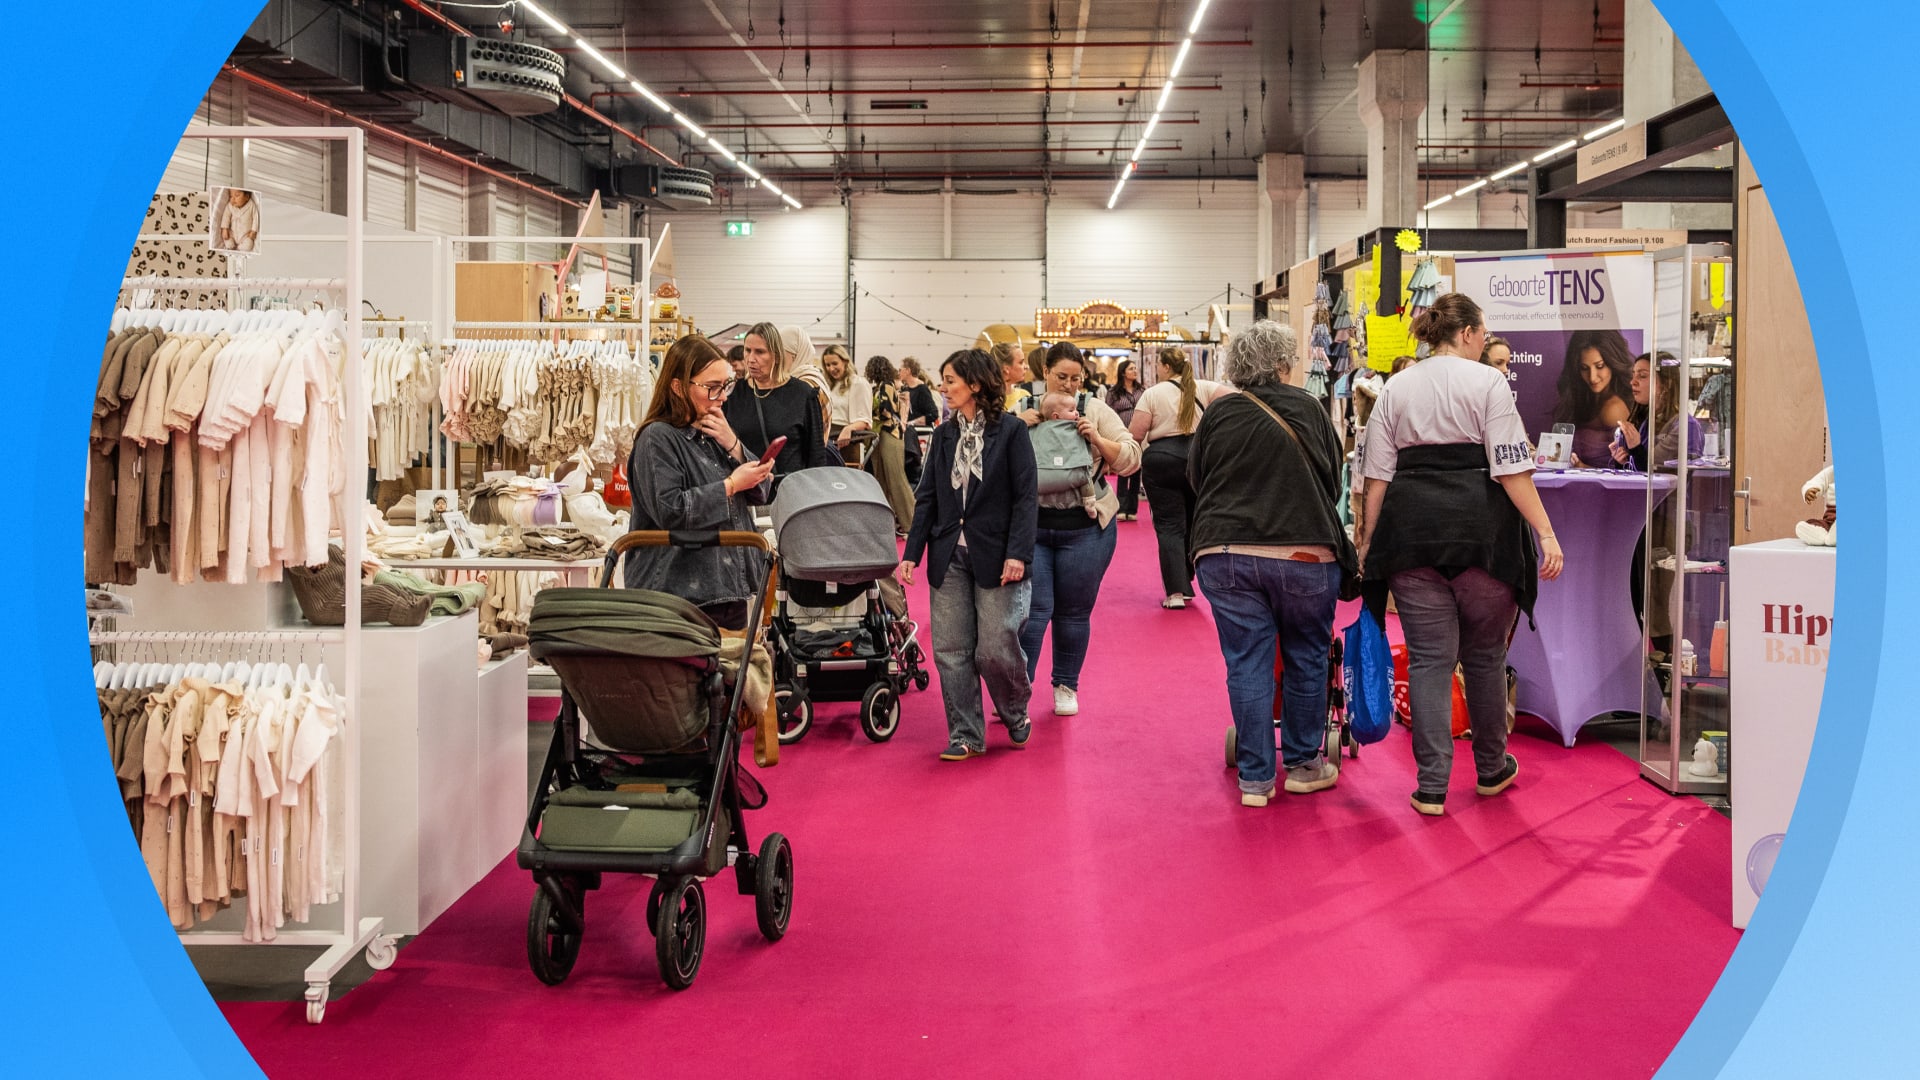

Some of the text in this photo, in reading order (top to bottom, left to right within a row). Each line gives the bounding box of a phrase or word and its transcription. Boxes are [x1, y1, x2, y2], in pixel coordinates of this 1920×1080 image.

[1585, 236, 1607, 244] Brand
[1609, 236, 1639, 244] Fashion
[1530, 310, 1557, 320] effectief
[1567, 310, 1604, 321] eenvoudig
[1761, 603, 1834, 646] Hip
